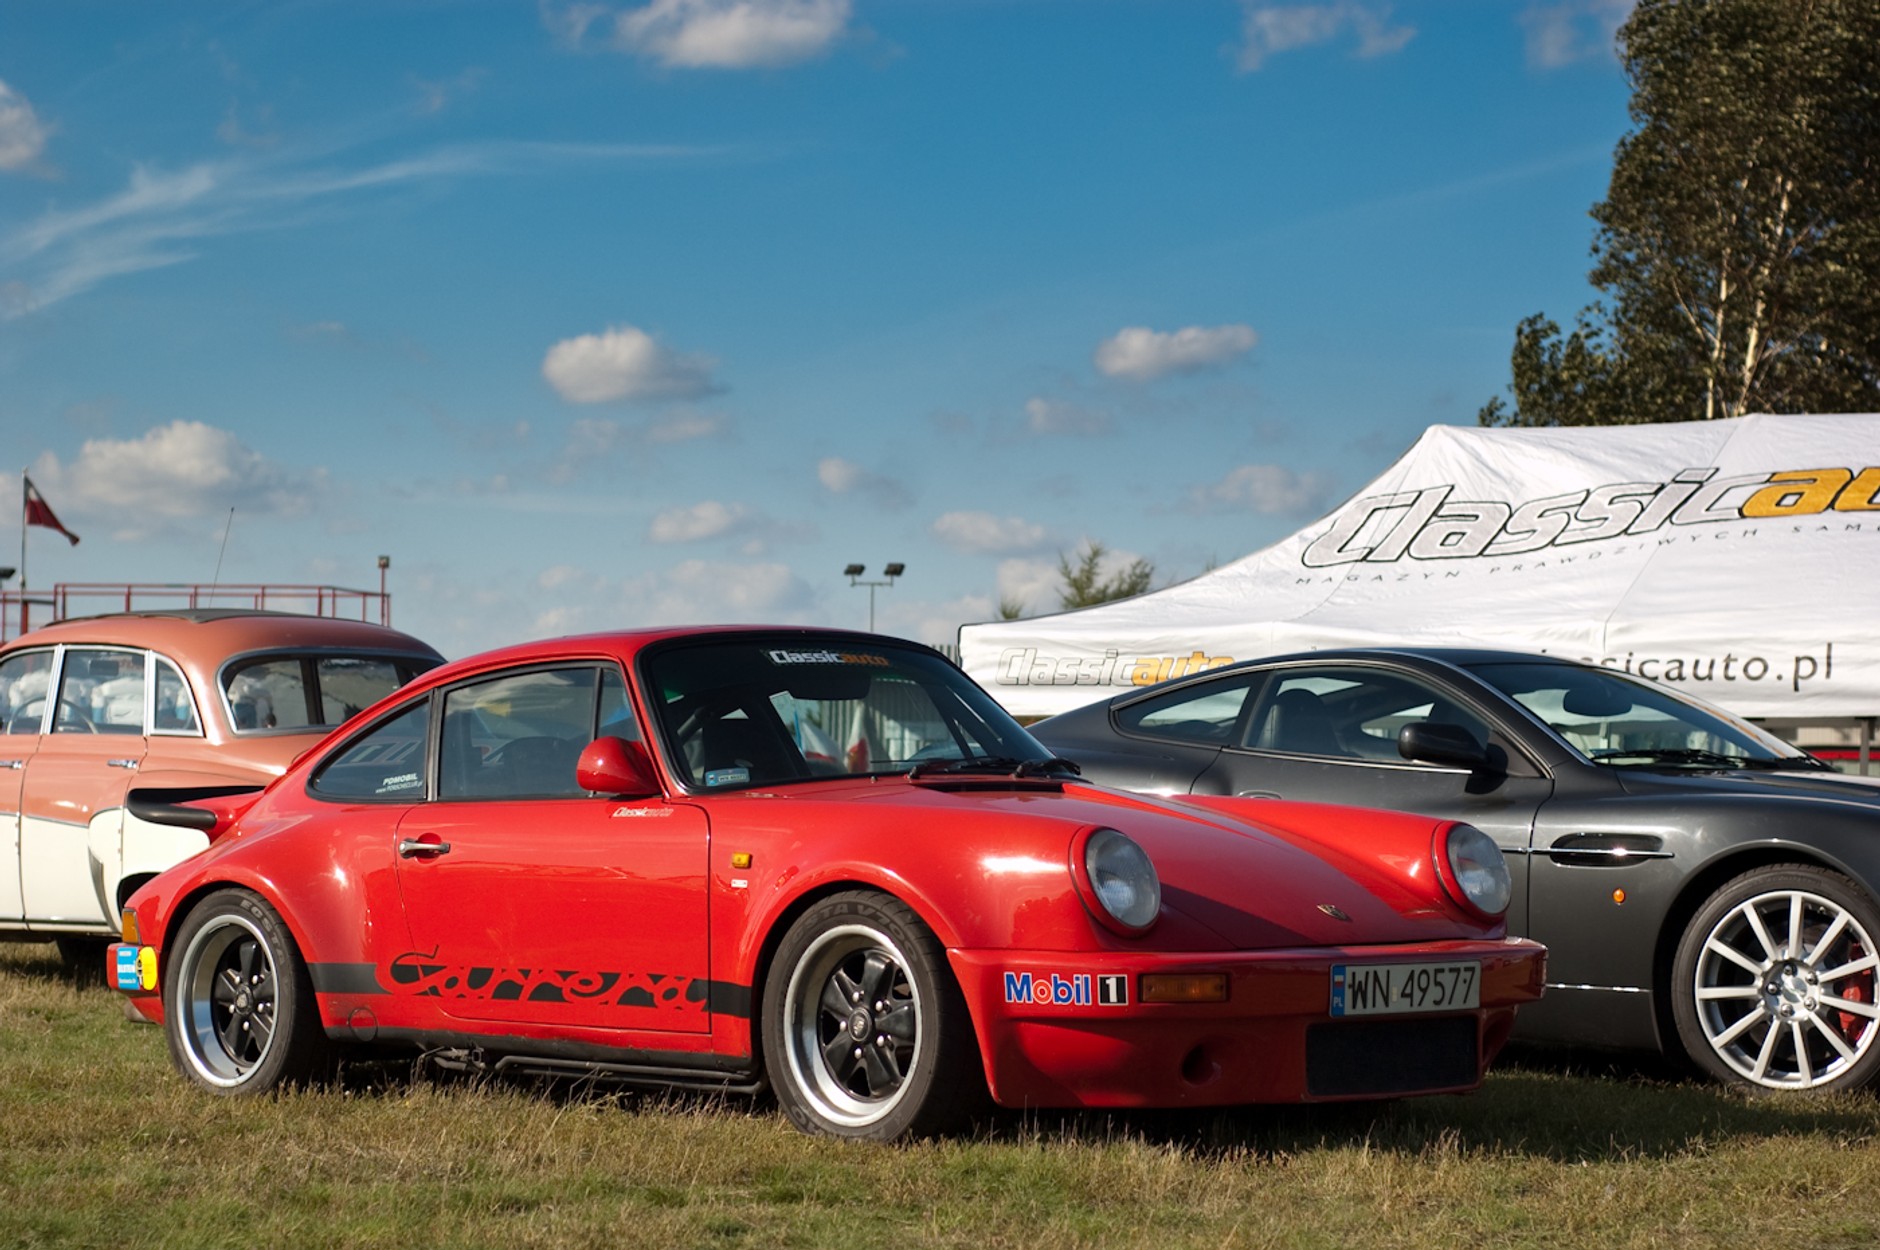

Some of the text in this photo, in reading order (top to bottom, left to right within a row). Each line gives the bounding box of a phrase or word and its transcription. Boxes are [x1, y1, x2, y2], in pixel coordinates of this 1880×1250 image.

[1296, 522, 1880, 585] MAGAZYN PRAWDZIWYCH SAM
[769, 650, 889, 666] Classicauto
[386, 944, 706, 1012] Carrera
[1004, 972, 1092, 1006] Mobil
[1350, 966, 1476, 1010] WN 49577
[1333, 996, 1344, 1008] PL
